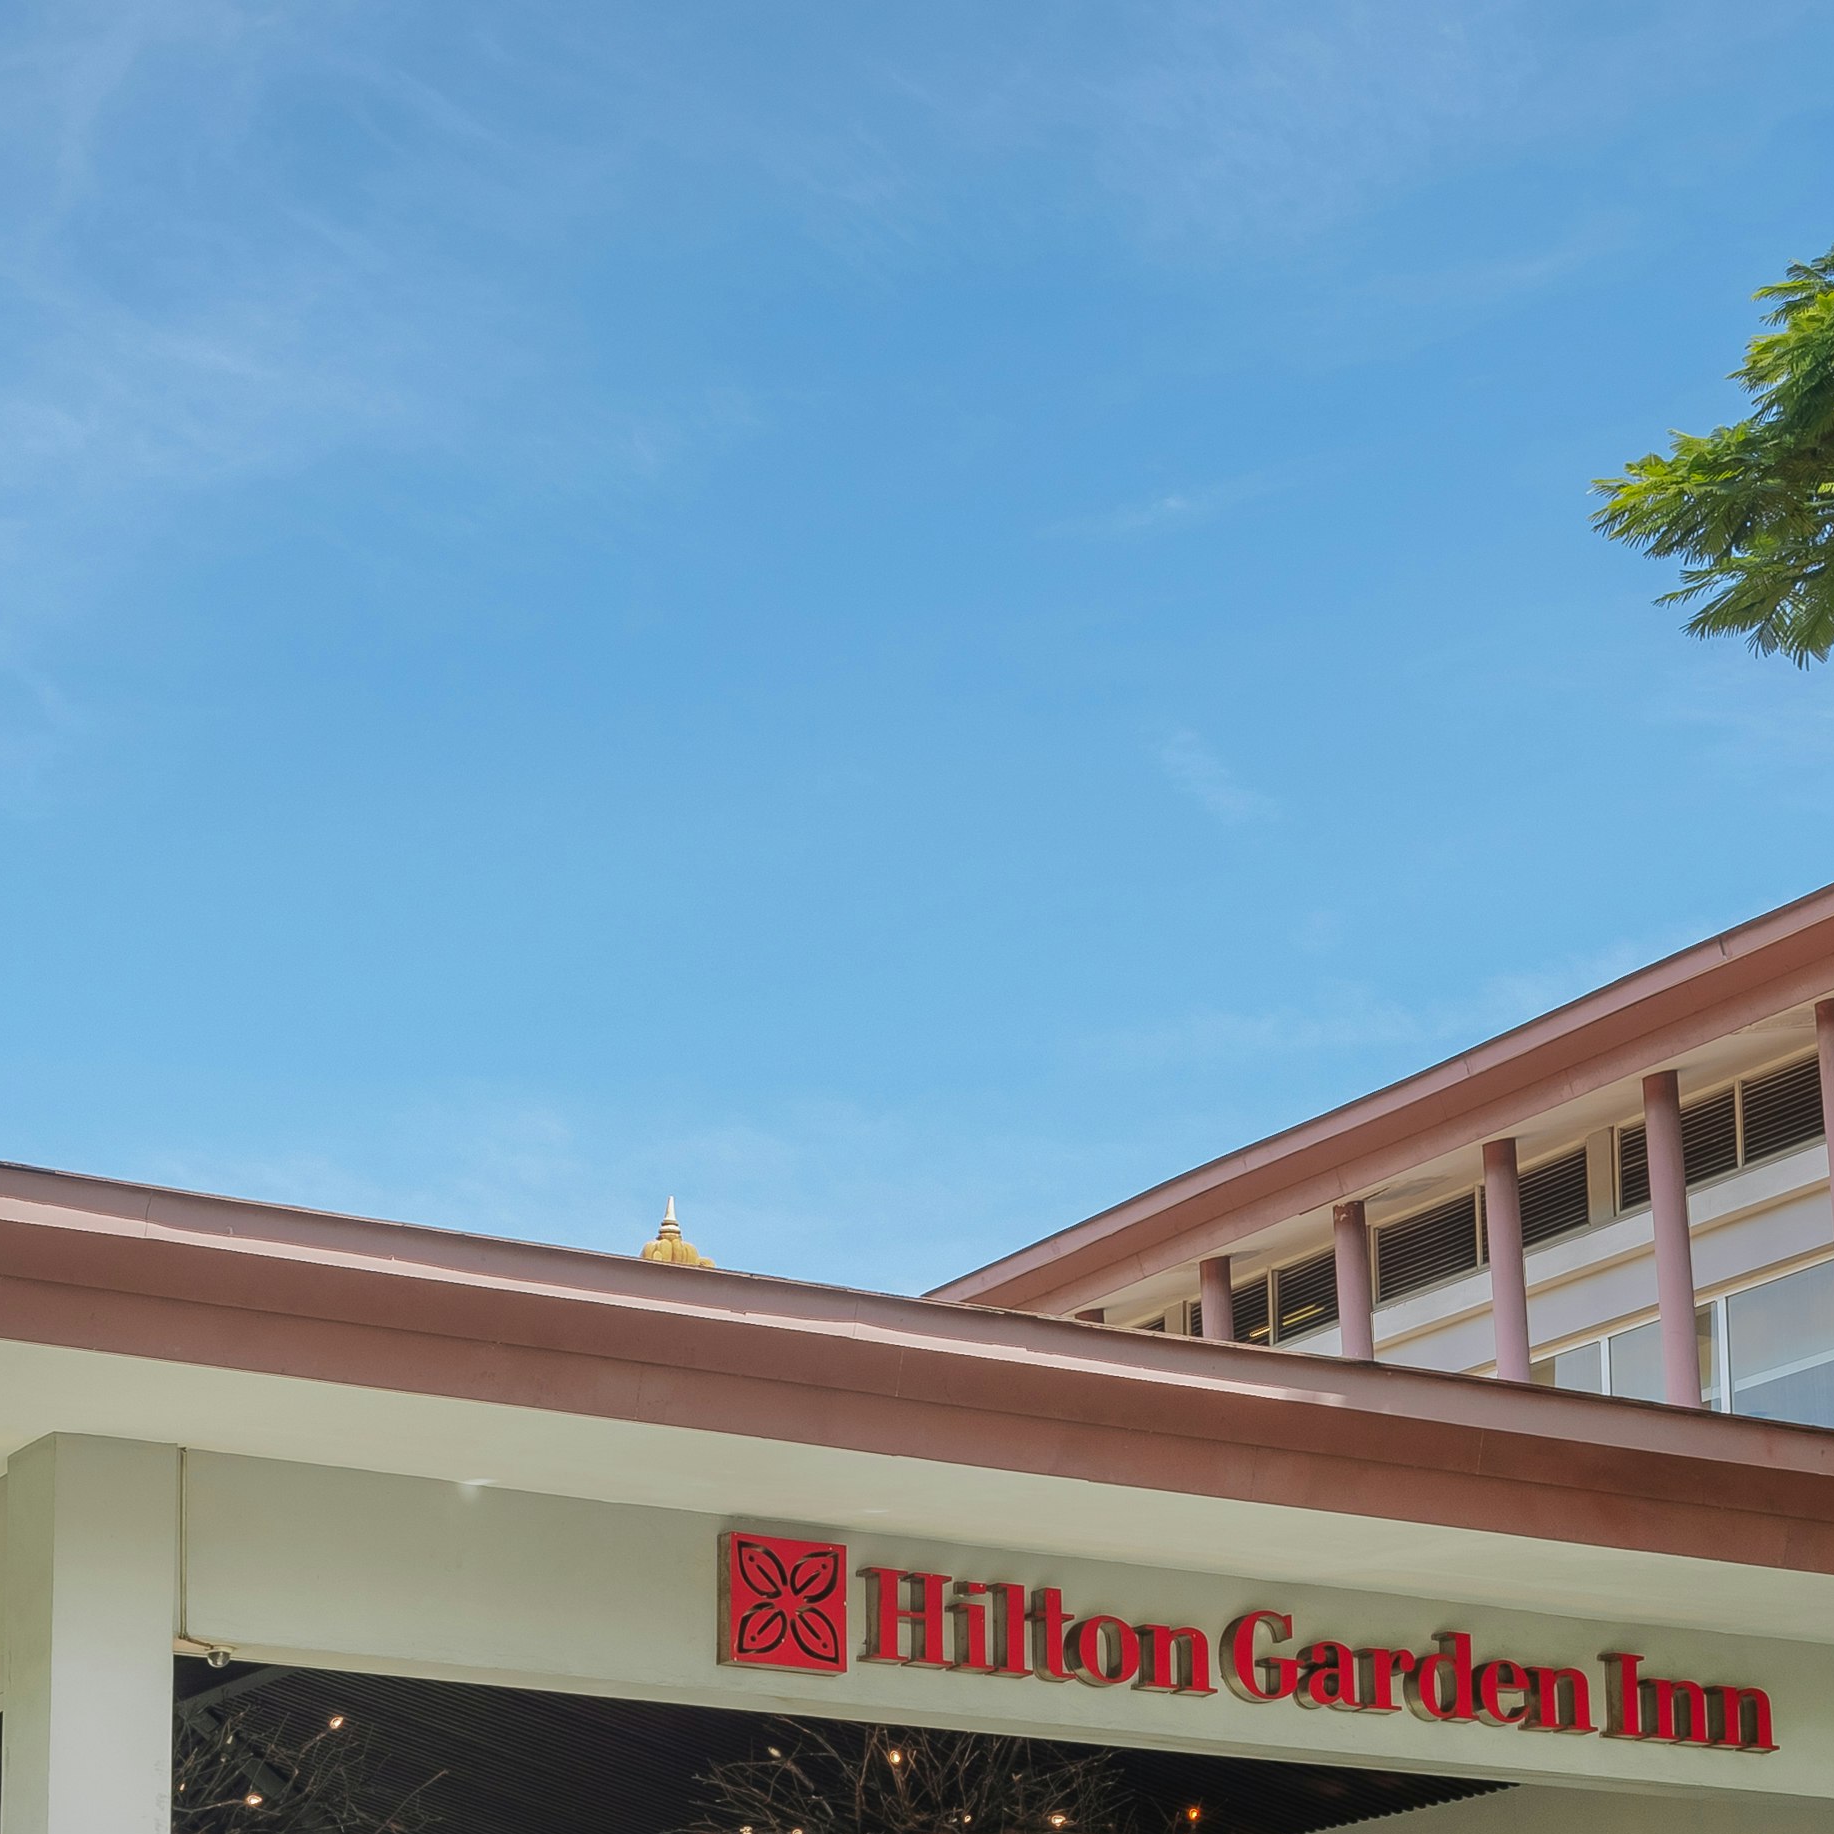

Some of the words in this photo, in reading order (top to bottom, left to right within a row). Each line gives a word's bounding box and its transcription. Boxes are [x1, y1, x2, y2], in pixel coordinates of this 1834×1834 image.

[862, 1567, 1218, 1695] Hilton
[1223, 1610, 1599, 1732] Garden
[1603, 1652, 1780, 1752] Inn
